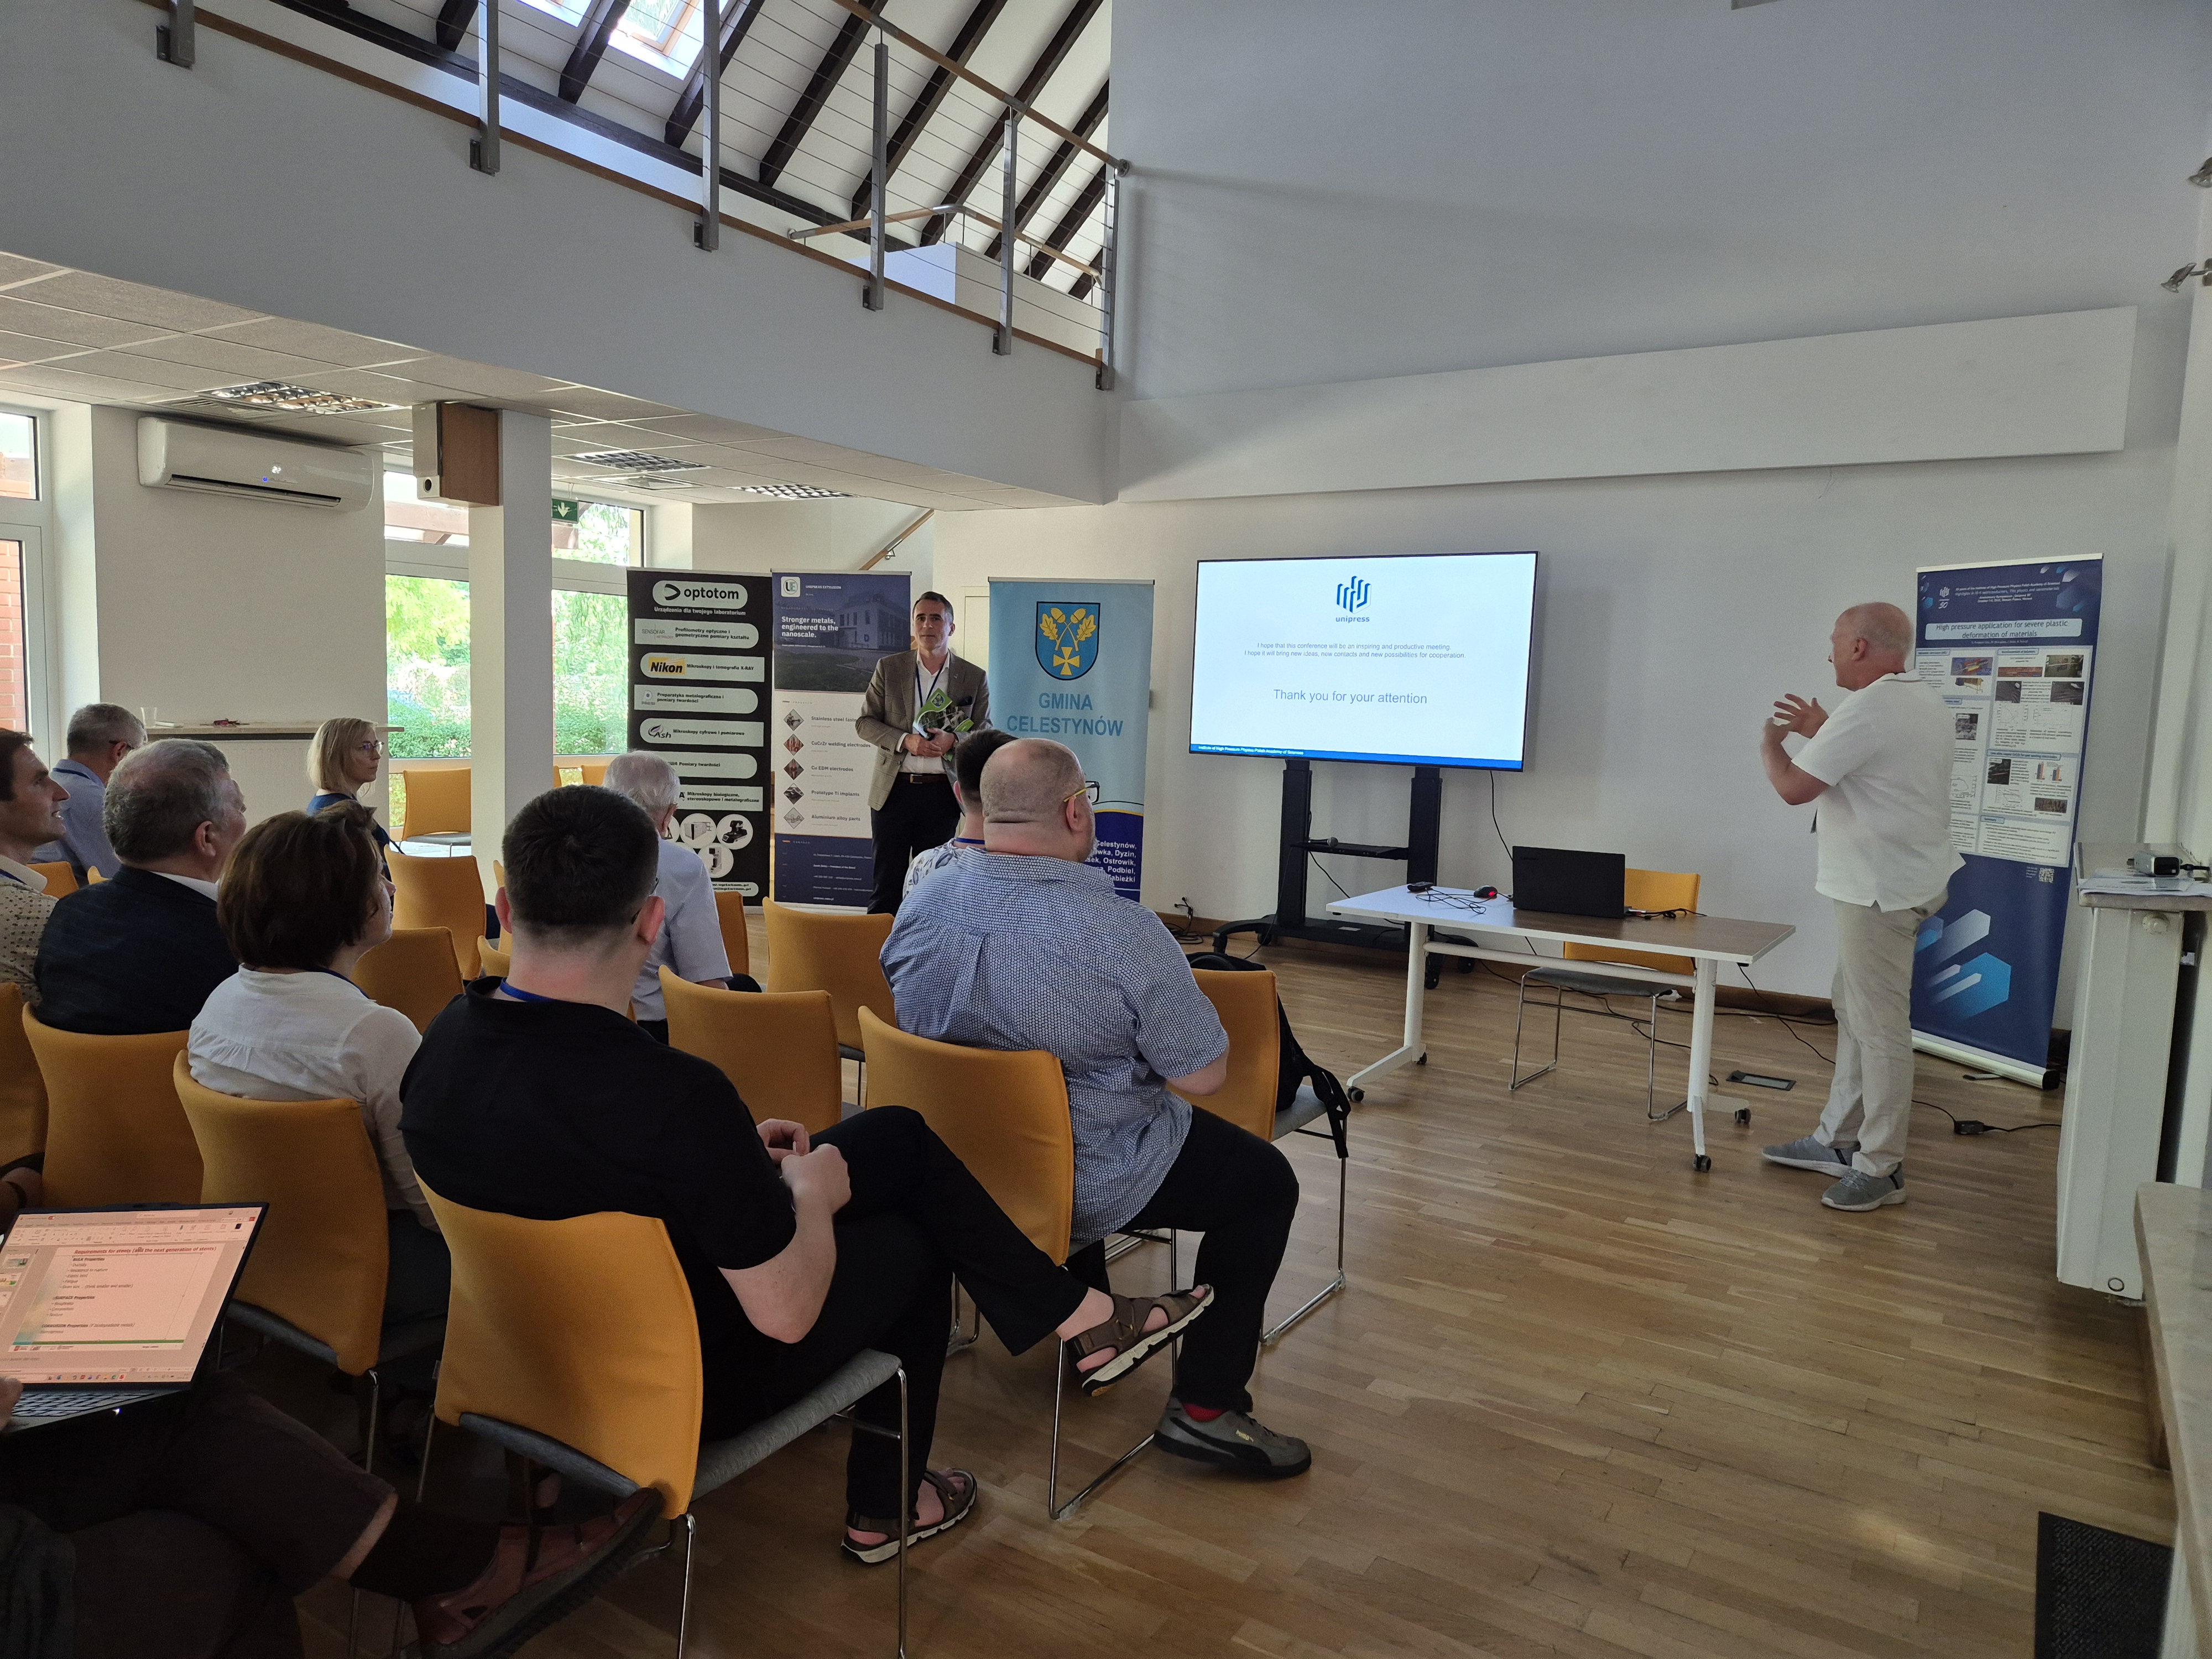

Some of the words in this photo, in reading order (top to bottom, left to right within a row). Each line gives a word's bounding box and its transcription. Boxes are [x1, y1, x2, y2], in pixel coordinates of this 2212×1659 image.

[684, 587, 739, 601] optotom
[781, 616, 810, 624] Stronger
[1978, 622, 2012, 631] application
[2046, 620, 2068, 628] plastic
[650, 662, 683, 673] Nikon
[1039, 692, 1093, 711] GMINA
[1274, 689, 1306, 700] Thank
[1310, 692, 1328, 703] you
[1332, 691, 1347, 701] for
[1350, 693, 1375, 704] your
[1378, 692, 1427, 704] attention
[1006, 715, 1123, 737] CELESTYNÓW
[1115, 849, 1136, 858] Dyzin,
[1103, 857, 1136, 867] Ostrowik,
[1108, 865, 1135, 875] Podbiel,
